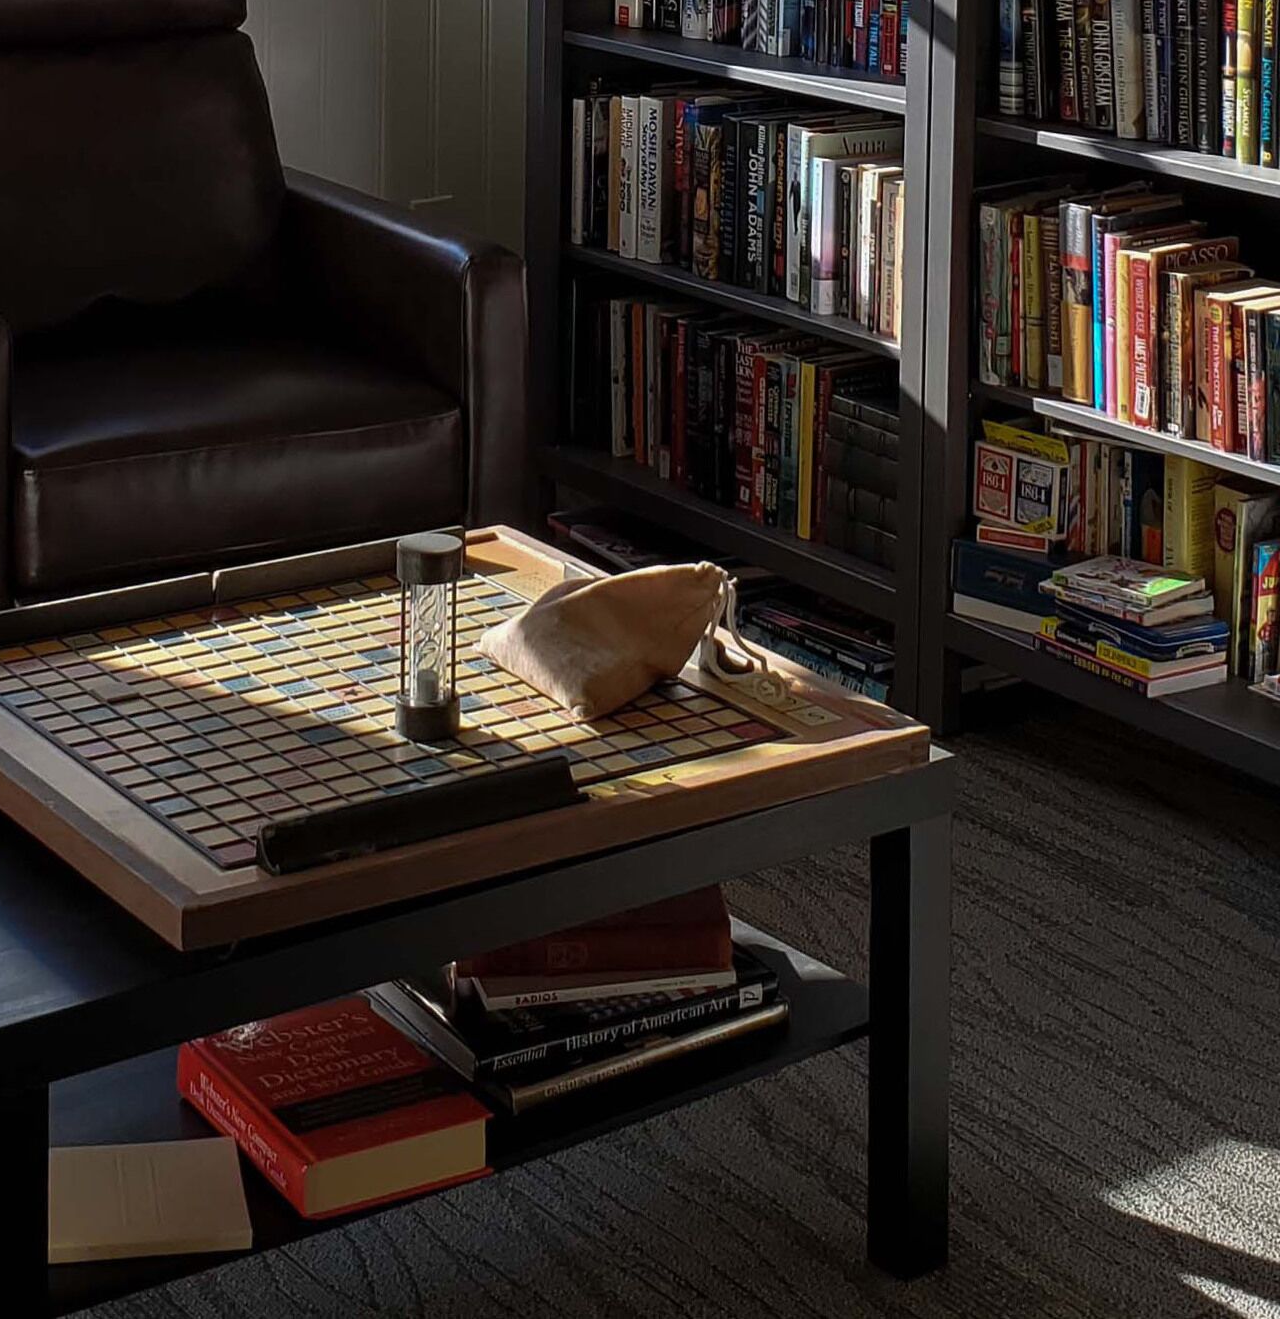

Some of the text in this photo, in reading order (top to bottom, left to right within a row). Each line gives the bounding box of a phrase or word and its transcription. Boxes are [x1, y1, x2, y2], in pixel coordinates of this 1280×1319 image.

[1092, 19, 1110, 106] JOHN GRISHAM
[747, 149, 758, 262] JOHN ADAMS
[1166, 245, 1228, 269] PICASSO
[1049, 253, 1059, 349] FLY BY NIGHT
[516, 992, 557, 1005] RADIOS
[287, 1045, 352, 1067] Desk
[492, 997, 731, 1072] Essential History of American Art
[258, 1046, 398, 1089] Dictionary
[269, 1059, 415, 1101] and Style Guide
